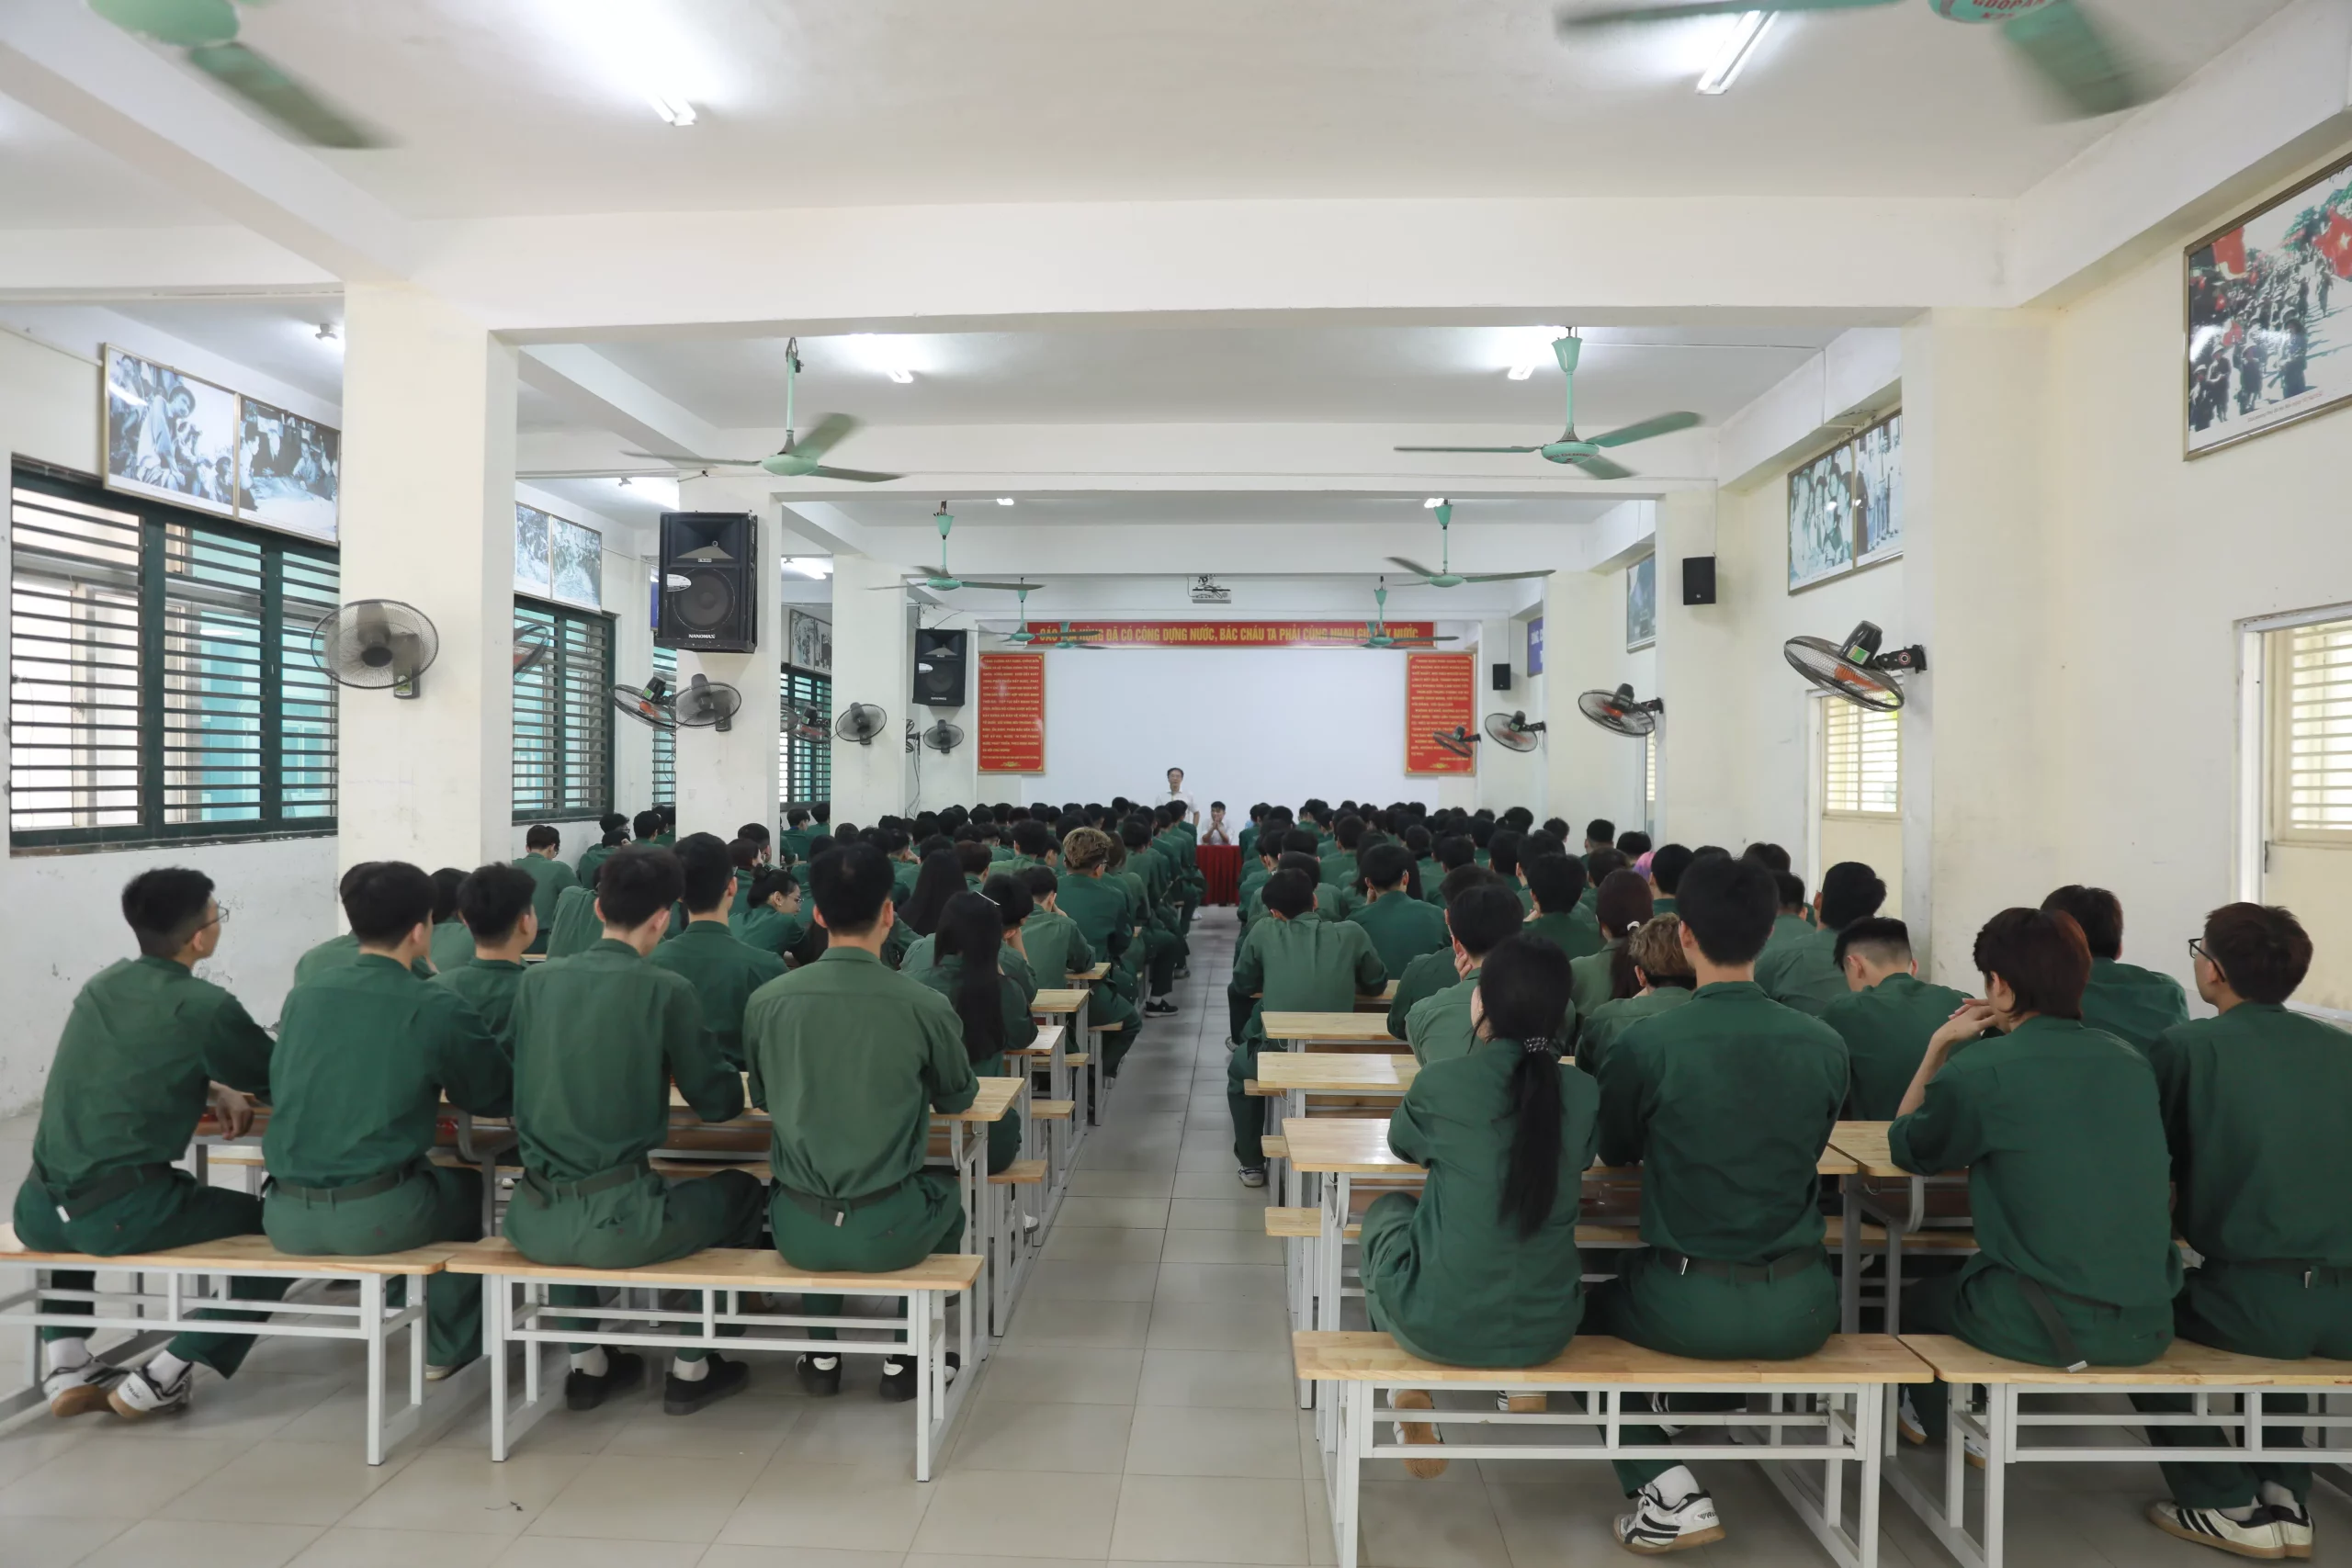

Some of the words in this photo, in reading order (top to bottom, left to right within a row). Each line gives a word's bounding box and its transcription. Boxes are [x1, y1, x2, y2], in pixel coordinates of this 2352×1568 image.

[1106, 626, 1119, 641] ĐÃ
[1121, 626, 1132, 641] CÓ
[1135, 626, 1159, 641] CÔNG
[1162, 626, 1187, 644] DỰNG
[1190, 624, 1217, 642] NƯỚC,
[1219, 625, 1238, 641] BÁC
[1240, 625, 1264, 641] CHÁU
[1267, 628, 1277, 641] TA
[1279, 624, 1300, 641] PHẢI
